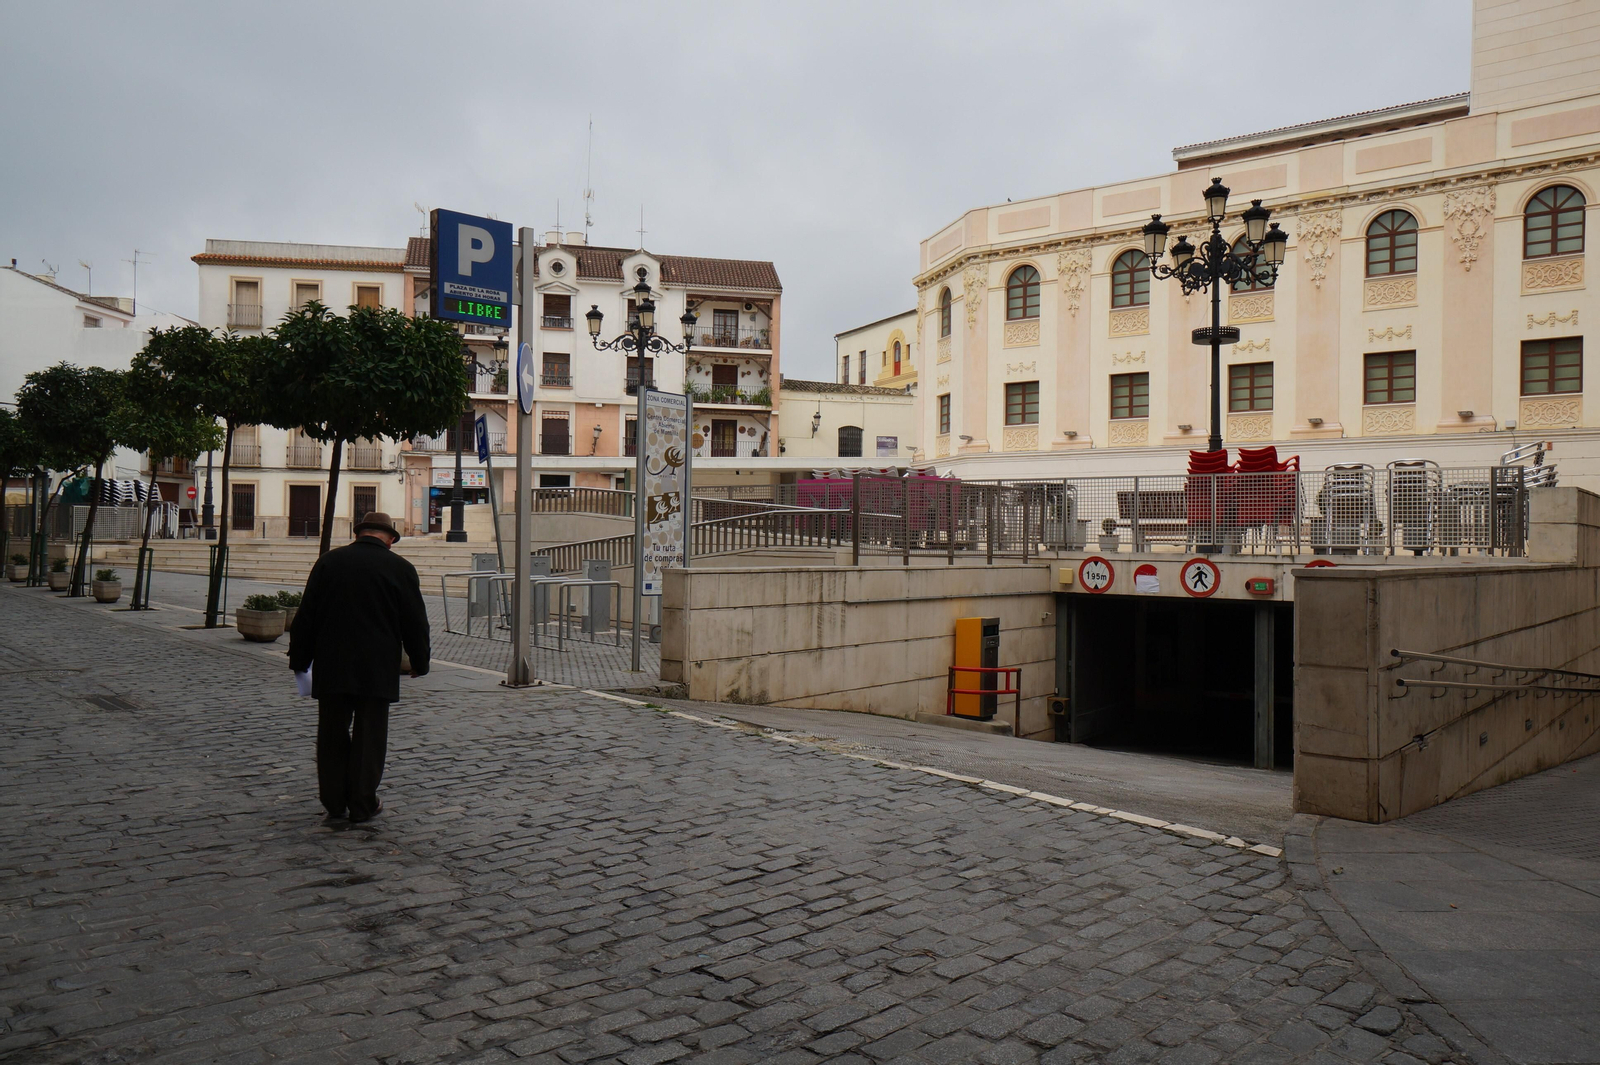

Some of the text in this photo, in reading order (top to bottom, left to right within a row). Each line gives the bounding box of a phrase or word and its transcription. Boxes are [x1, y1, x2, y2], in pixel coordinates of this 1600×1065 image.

[458, 223, 495, 277] P
[458, 300, 502, 320] LIBRE
[647, 394, 686, 406] ZONA COMERCIAL
[646, 412, 686, 424] Centro Comercial
[658, 422, 675, 430] Abierto
[476, 421, 484, 446] P
[652, 542, 676, 552] Tu ruta
[644, 554, 684, 564] de compras
[654, 566, 658, 574] y
